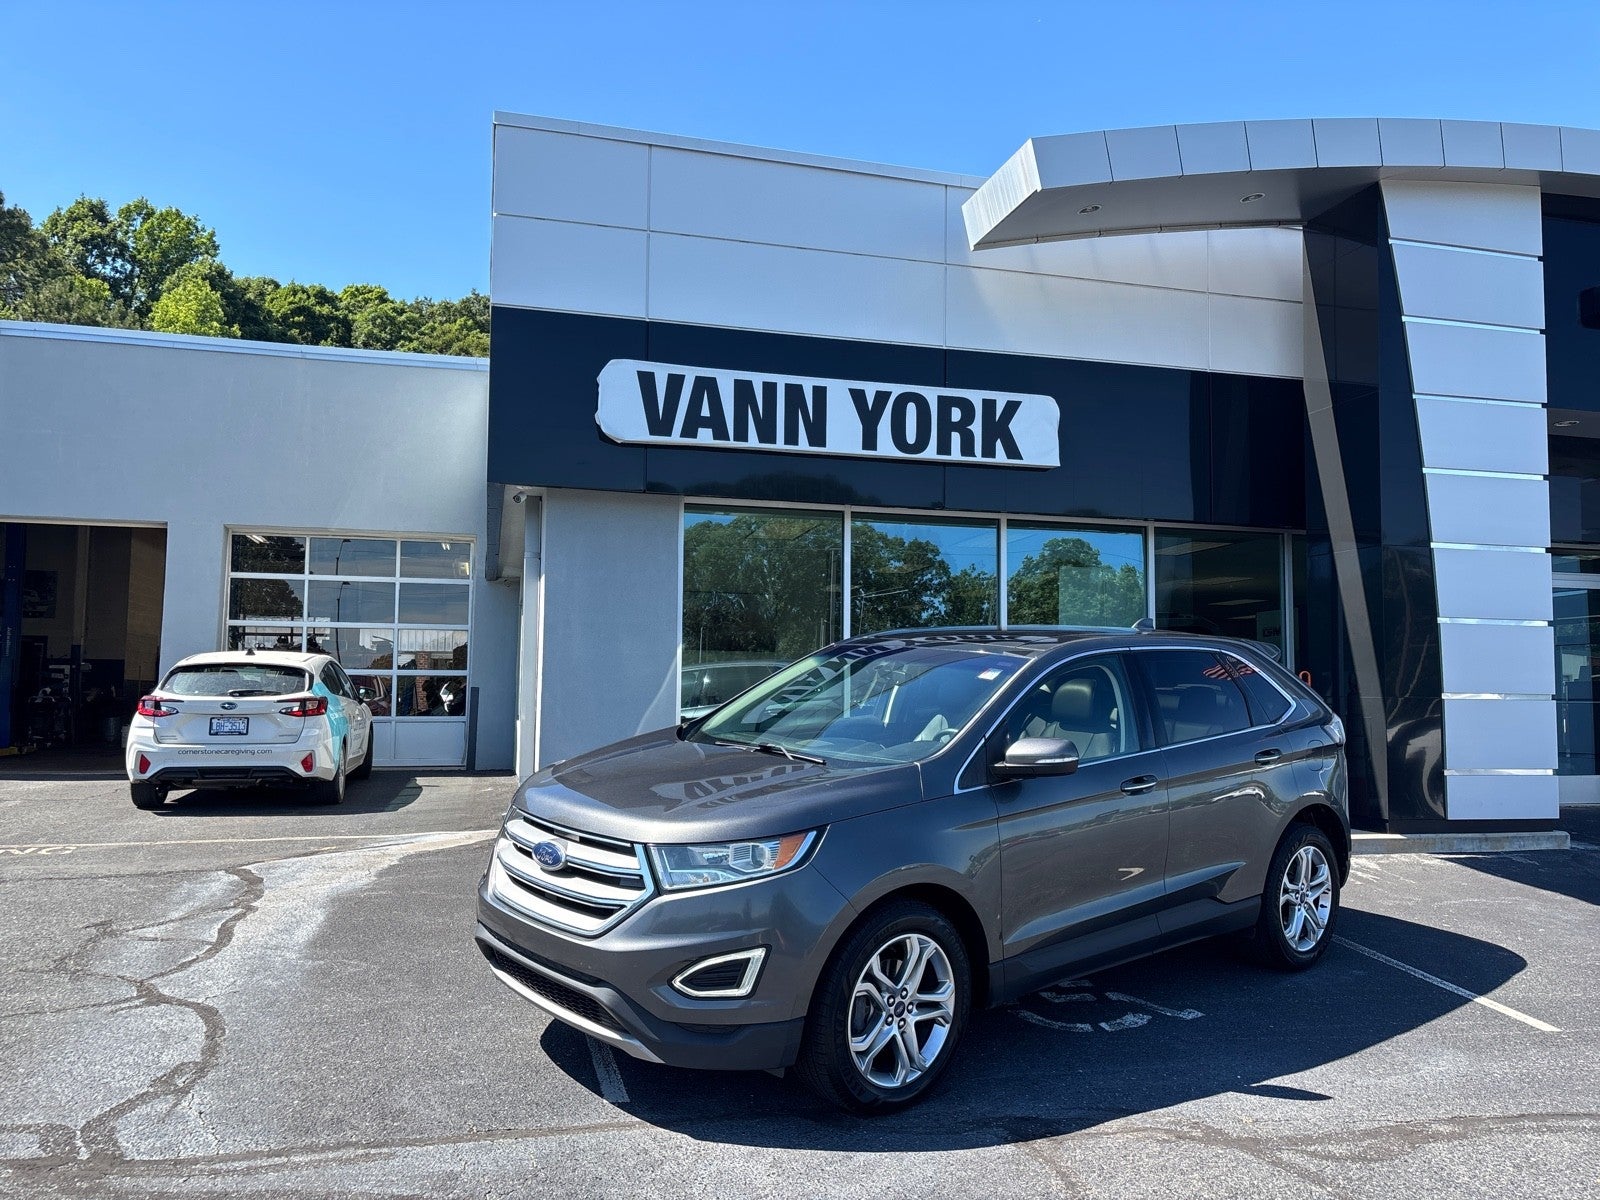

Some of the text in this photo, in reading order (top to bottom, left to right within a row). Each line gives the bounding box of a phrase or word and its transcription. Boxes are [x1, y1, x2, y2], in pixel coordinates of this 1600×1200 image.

[637, 370, 1024, 461] VANN YORK
[536, 845, 557, 865] Ford
